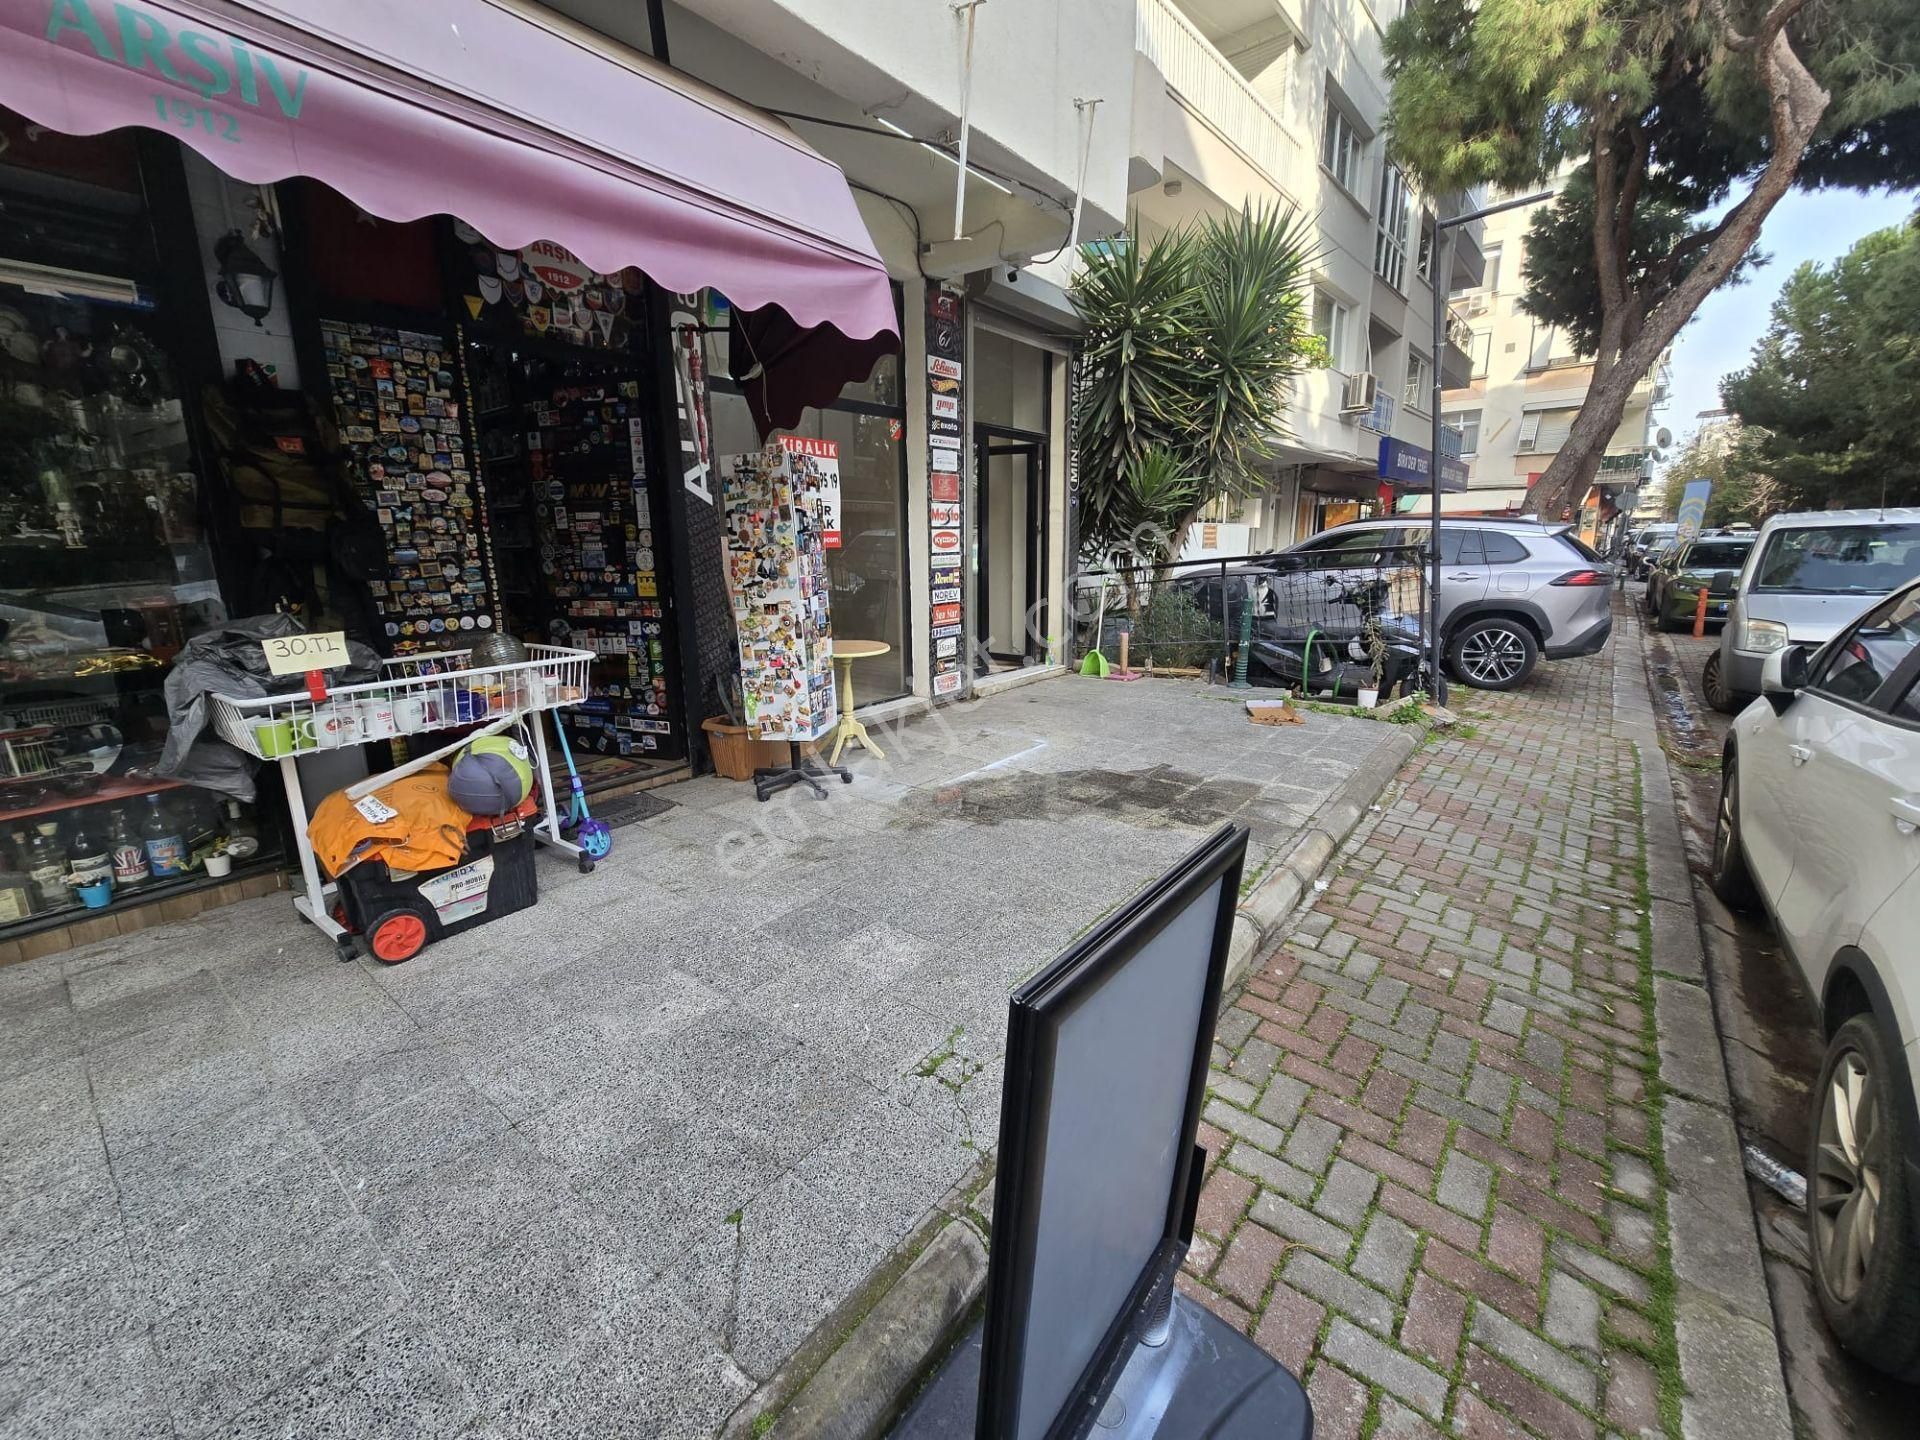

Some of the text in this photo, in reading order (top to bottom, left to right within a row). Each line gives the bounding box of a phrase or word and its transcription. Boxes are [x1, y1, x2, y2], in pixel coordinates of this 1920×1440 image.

[45, 0, 308, 120] ARŞİV
[151, 94, 242, 144] 1912
[546, 271, 570, 285] 1912
[779, 438, 838, 457] KİRALIK
